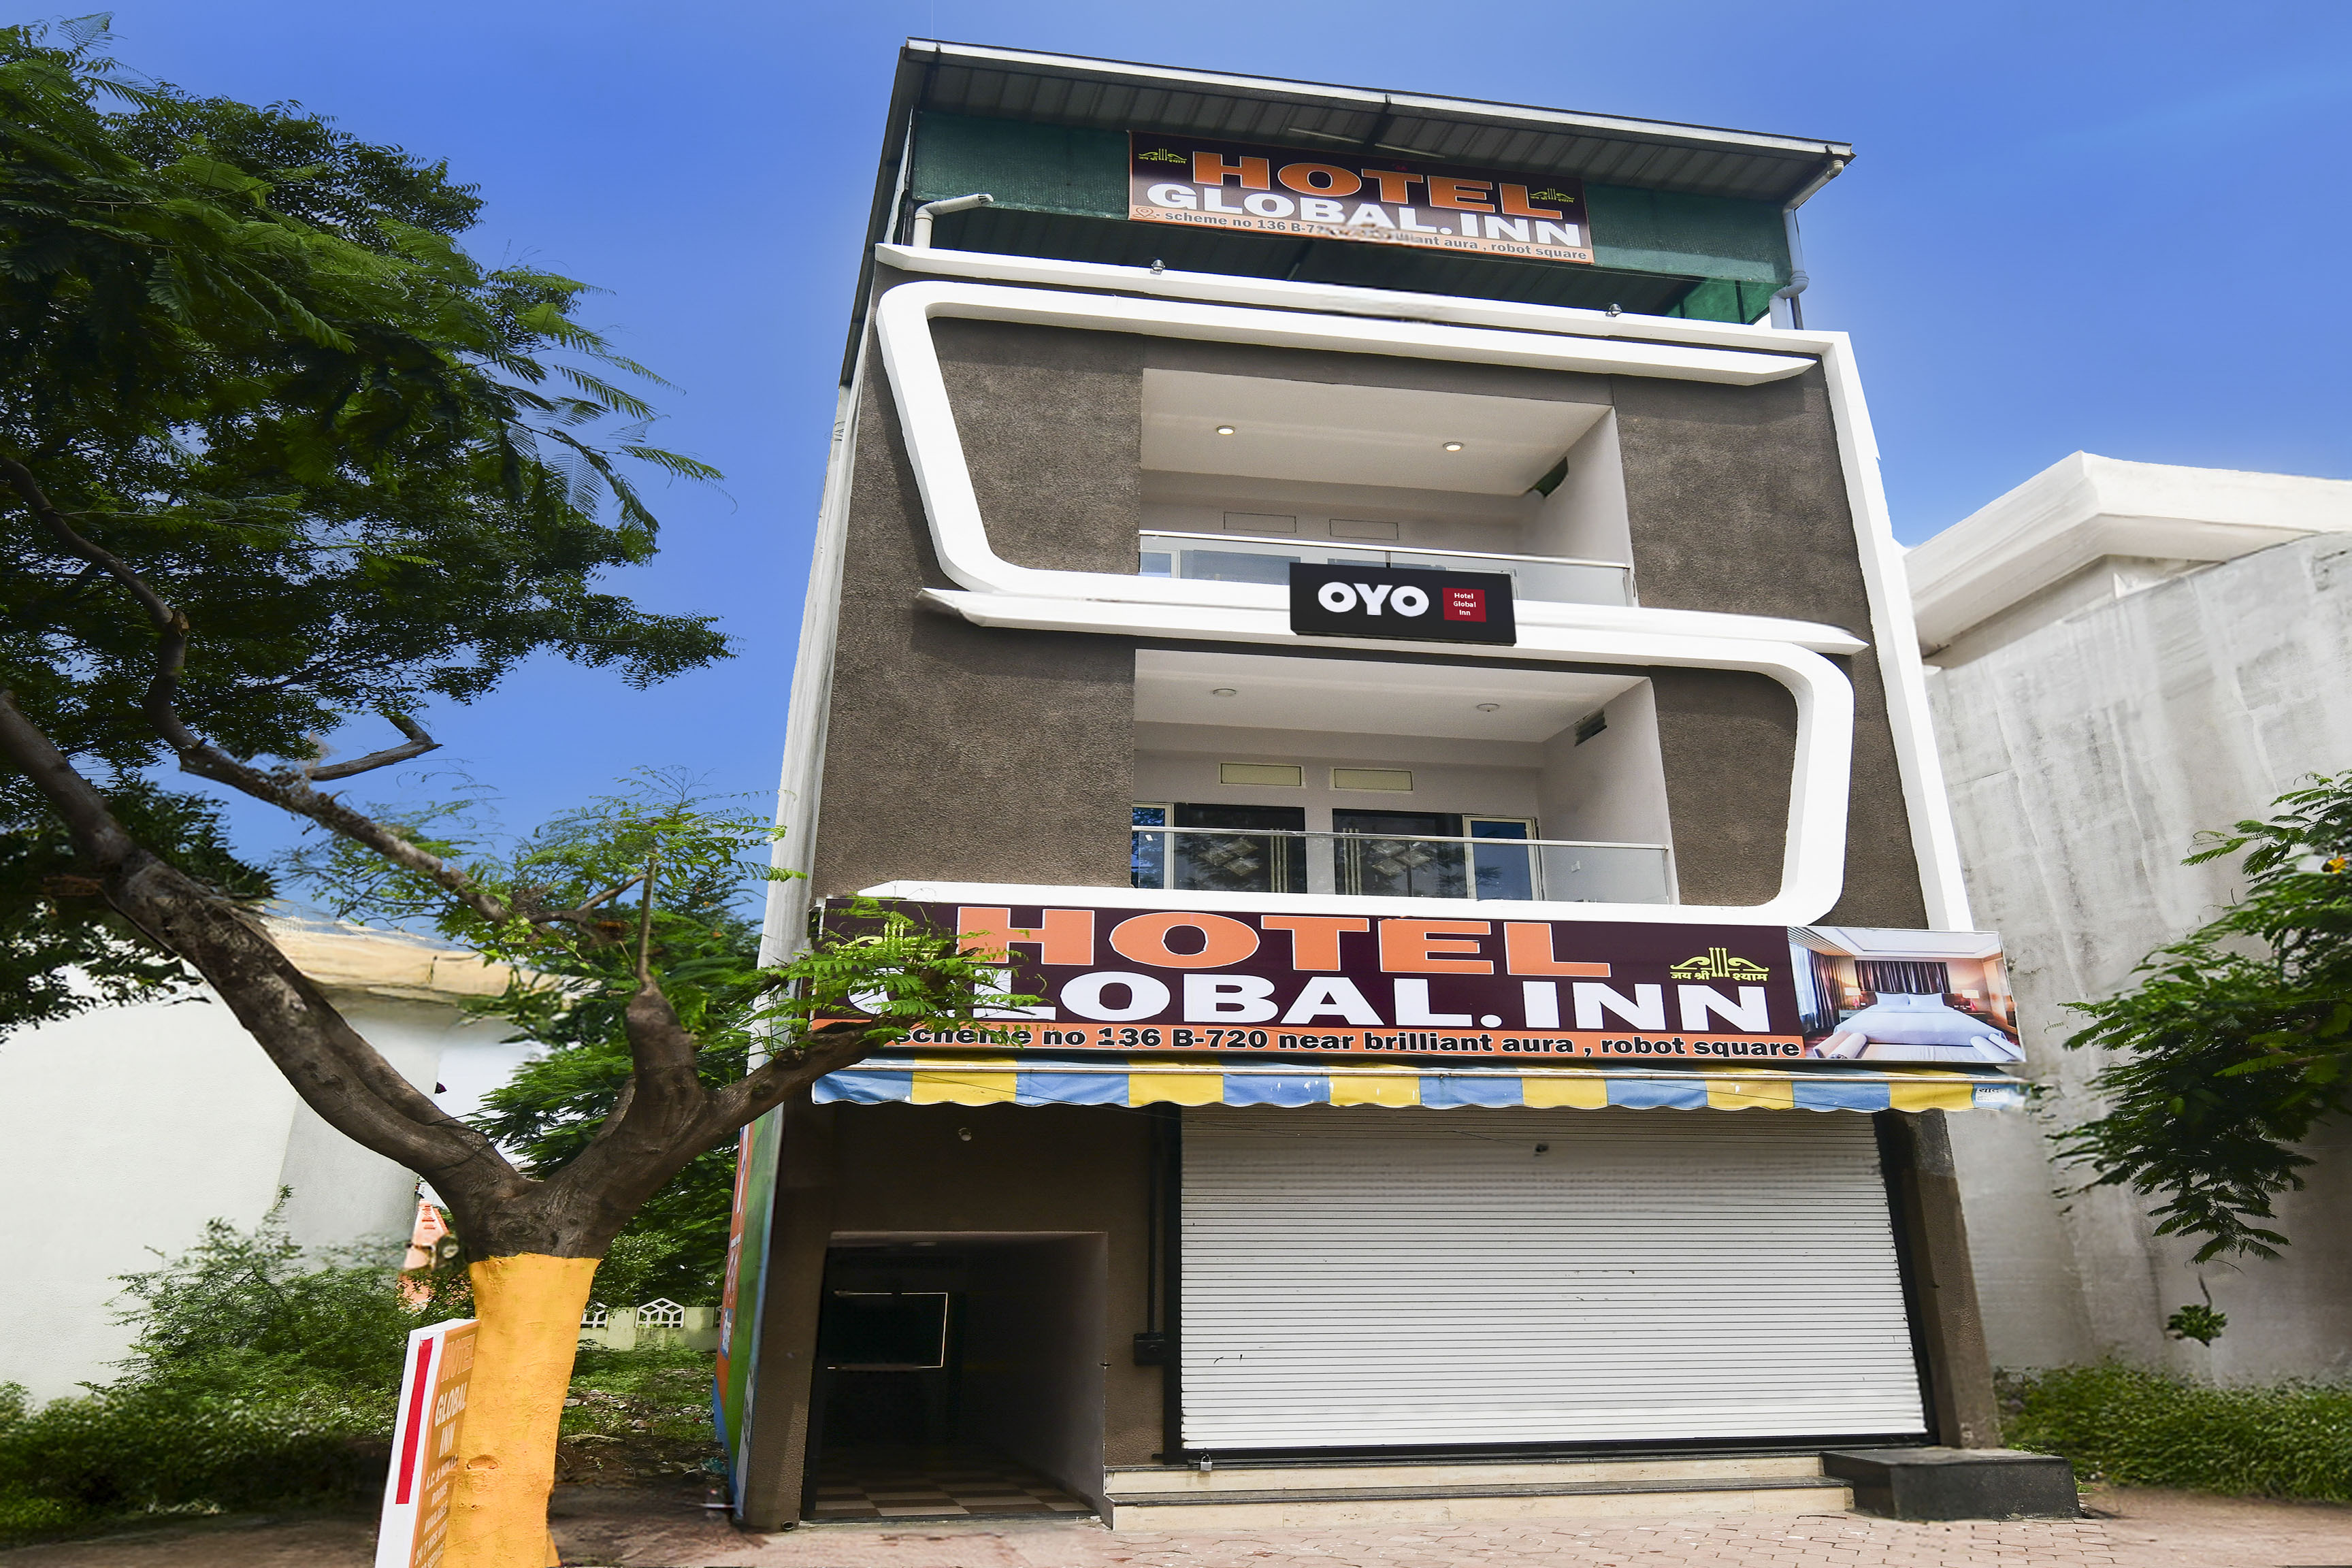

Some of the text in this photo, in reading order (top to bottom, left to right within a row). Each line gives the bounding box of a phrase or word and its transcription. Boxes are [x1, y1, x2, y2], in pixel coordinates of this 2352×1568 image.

[1192, 151, 1563, 220] HOTEL
[1165, 211, 1227, 225] scheme
[1232, 219, 1252, 227] no
[1257, 219, 1286, 231] 136
[1443, 239, 1478, 249] aura
[1491, 244, 1531, 255] robot
[1535, 247, 1587, 259] square
[1318, 582, 1429, 617] OYO
[1453, 600, 1476, 608] Global
[956, 906, 1612, 977] HOTEL
[1669, 970, 1768, 981] जय श्री श्याम
[1043, 1028, 1086, 1046] no
[1097, 1028, 1162, 1048] 136
[1172, 1028, 1269, 1049] B-720
[1278, 1034, 1354, 1049] near
[1364, 1032, 1494, 1052] brilliant
[1501, 1036, 1575, 1053] aura
[1601, 1036, 1686, 1055] robot
[1693, 1041, 1801, 1058] square
[435, 1382, 468, 1427] GLOBAL
[438, 1420, 456, 1458] INN
